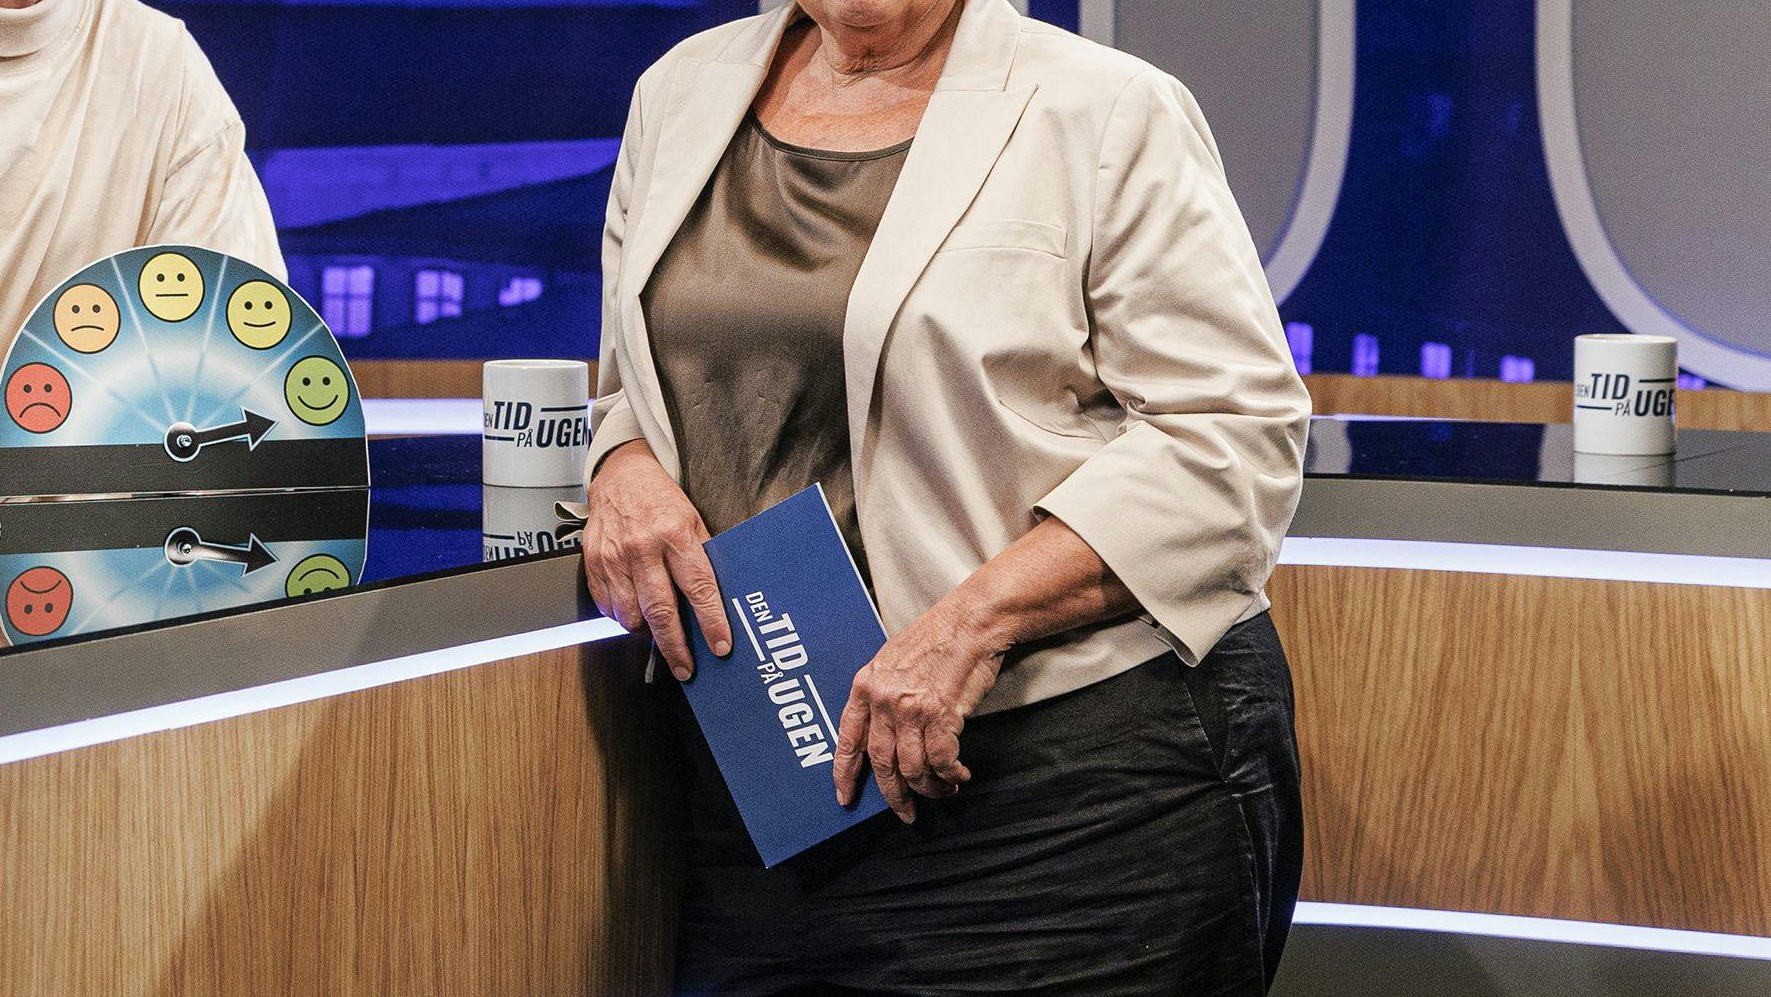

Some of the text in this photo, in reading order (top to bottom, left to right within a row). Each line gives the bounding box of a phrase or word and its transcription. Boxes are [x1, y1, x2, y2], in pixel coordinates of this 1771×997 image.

[1591, 373, 1630, 400] TID
[493, 400, 533, 431] TID
[1614, 399, 1631, 417] PÅ
[516, 428, 534, 448] PÅ
[744, 590, 809, 671] DEN TID
[756, 662, 834, 769] PÅ UGEN
